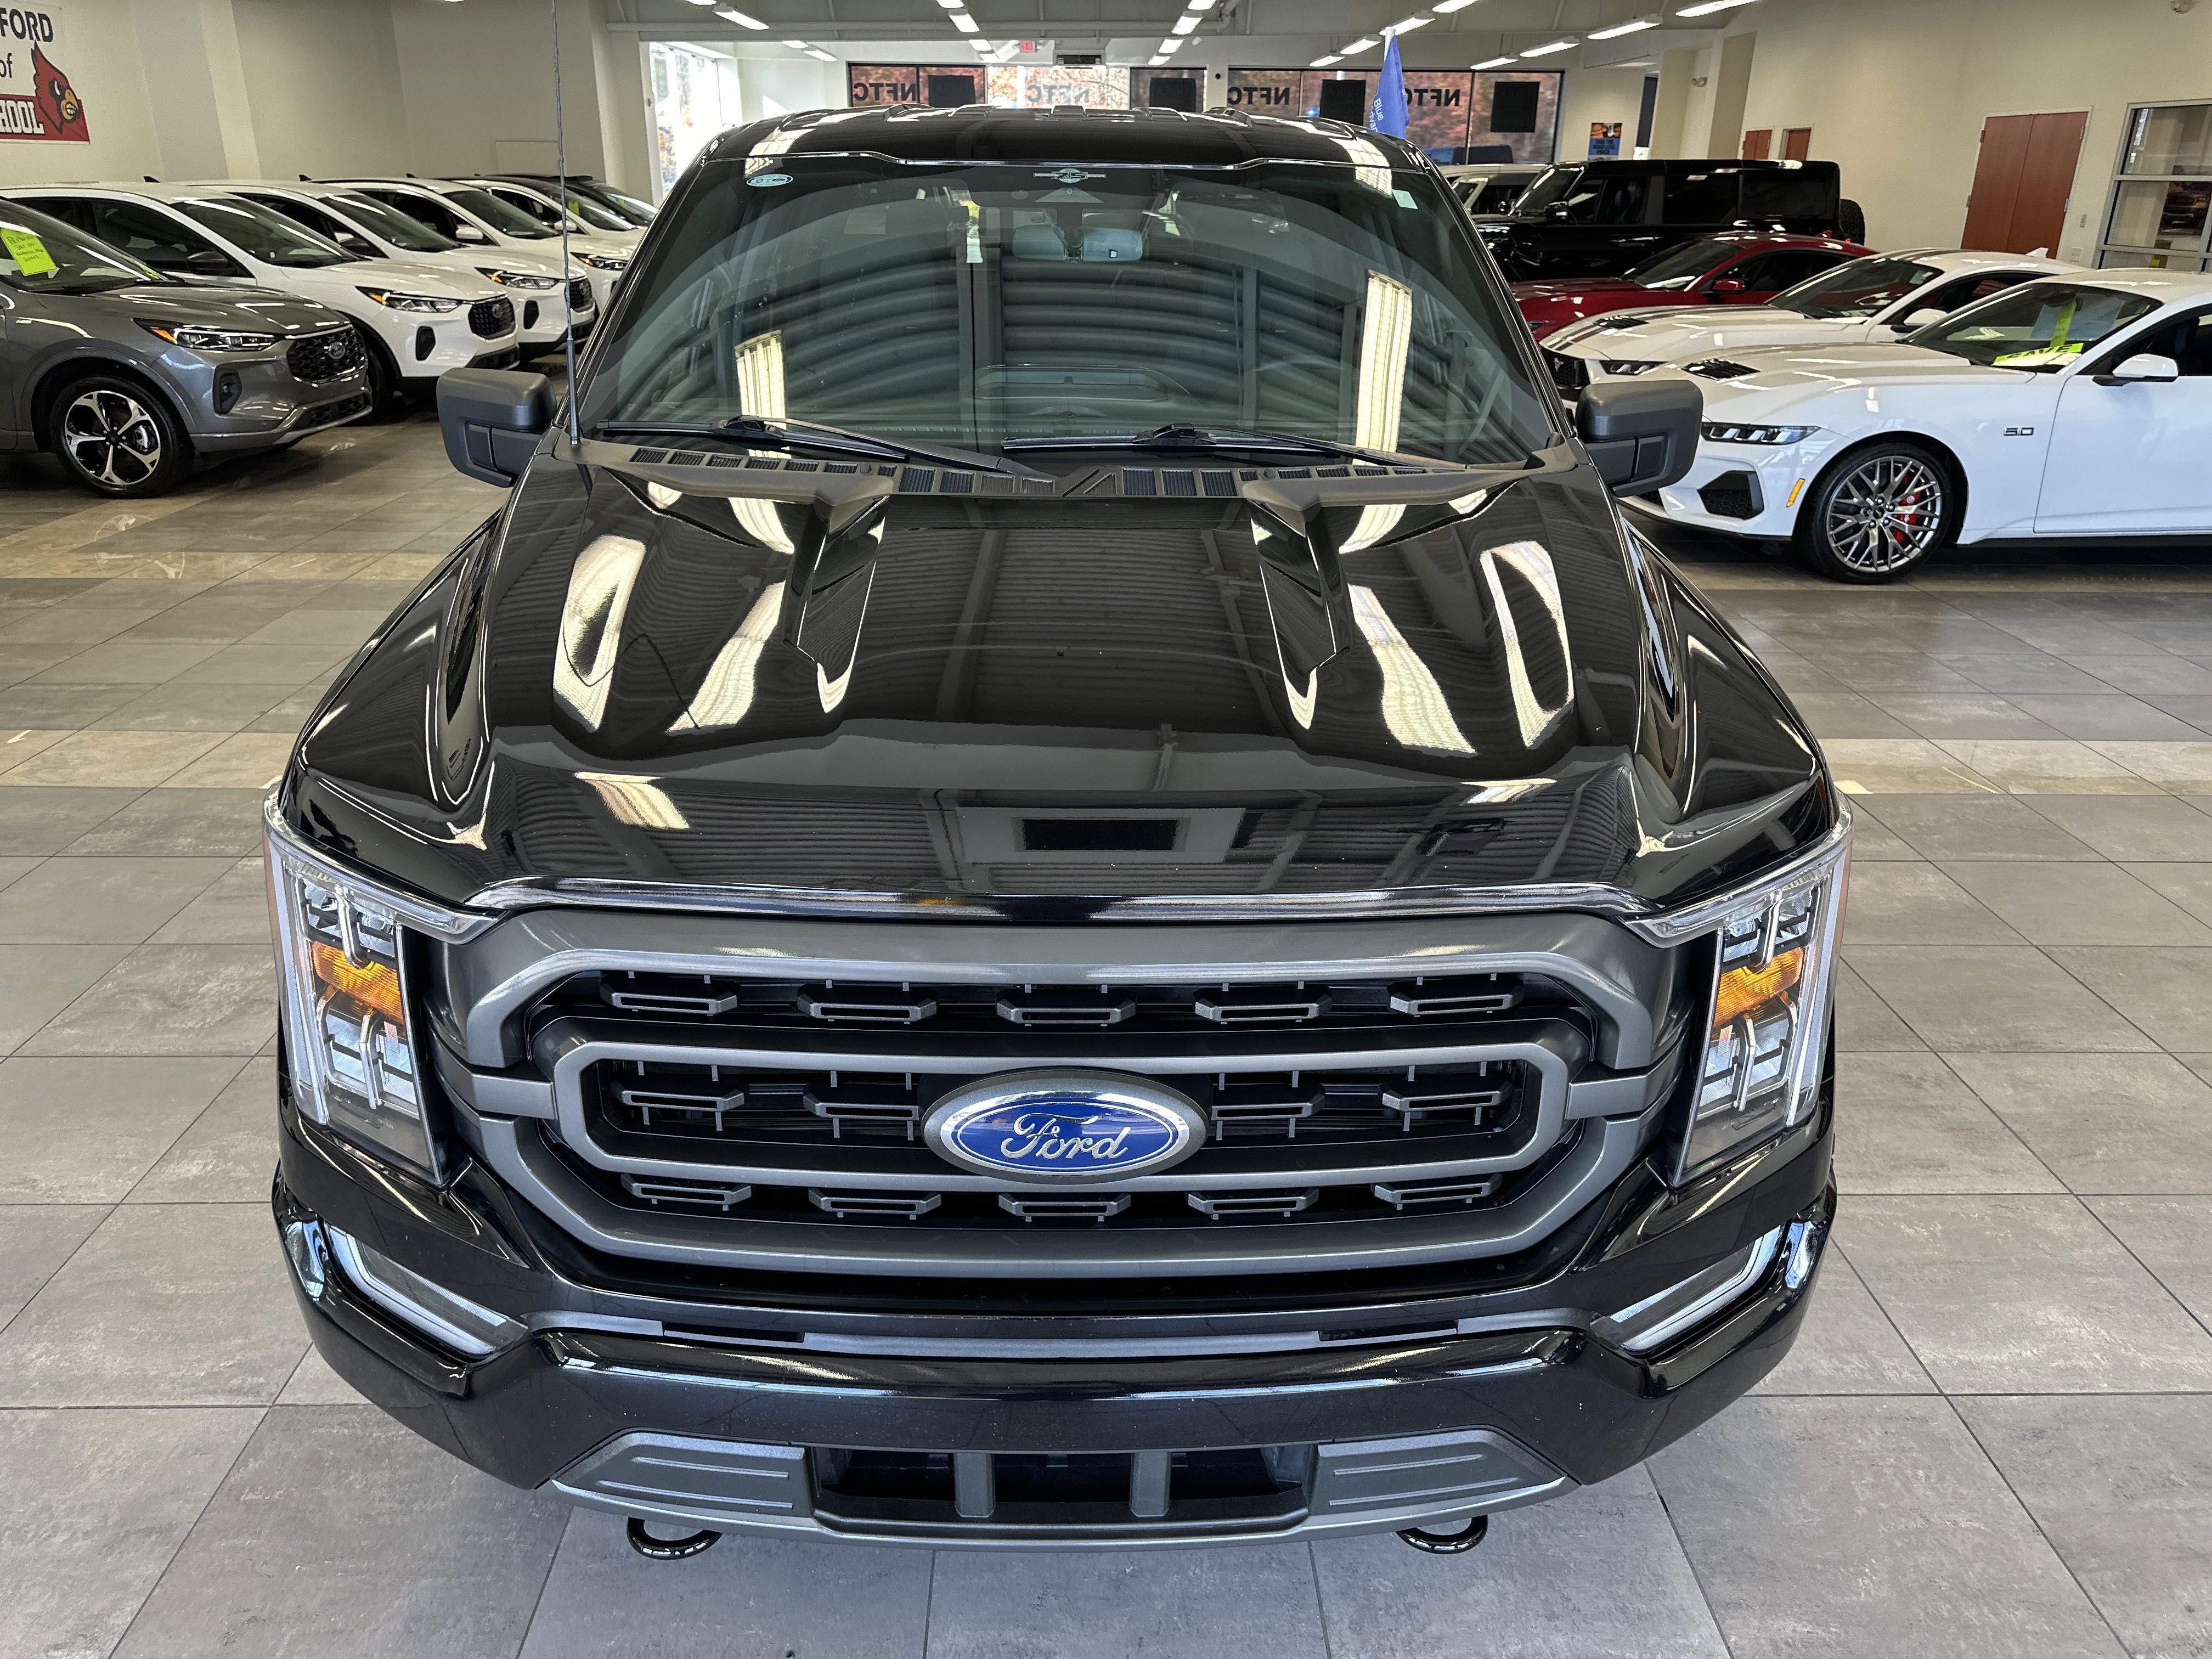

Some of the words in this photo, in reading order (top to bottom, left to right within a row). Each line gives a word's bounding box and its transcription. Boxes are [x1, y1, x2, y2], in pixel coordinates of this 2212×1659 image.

[0, 7, 54, 43] FORD
[1373, 98, 1384, 121] Blue
[1000, 1113, 1132, 1160] Ford
